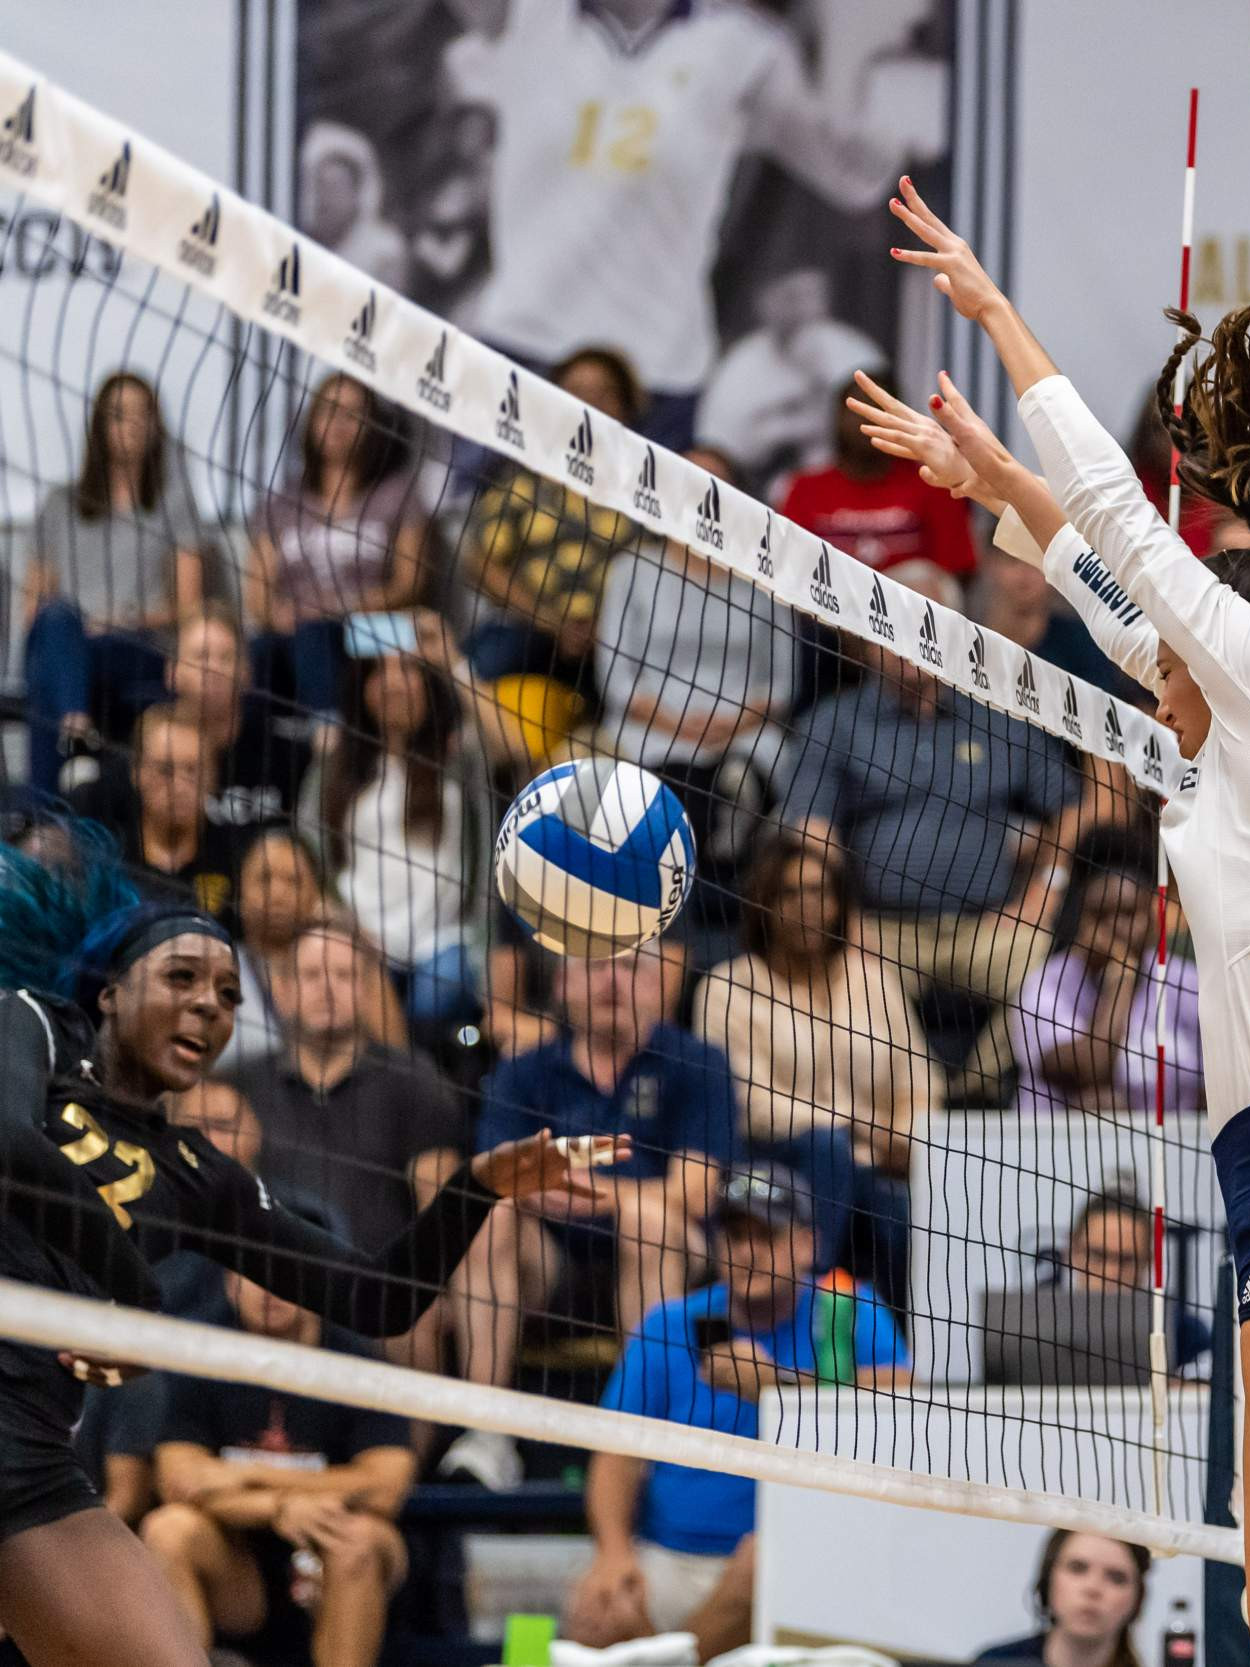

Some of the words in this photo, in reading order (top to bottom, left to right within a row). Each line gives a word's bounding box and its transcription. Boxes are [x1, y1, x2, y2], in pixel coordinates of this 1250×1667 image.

[809, 580, 841, 615] adidas
[868, 610, 895, 643] adidas
[919, 638, 944, 669] adidas
